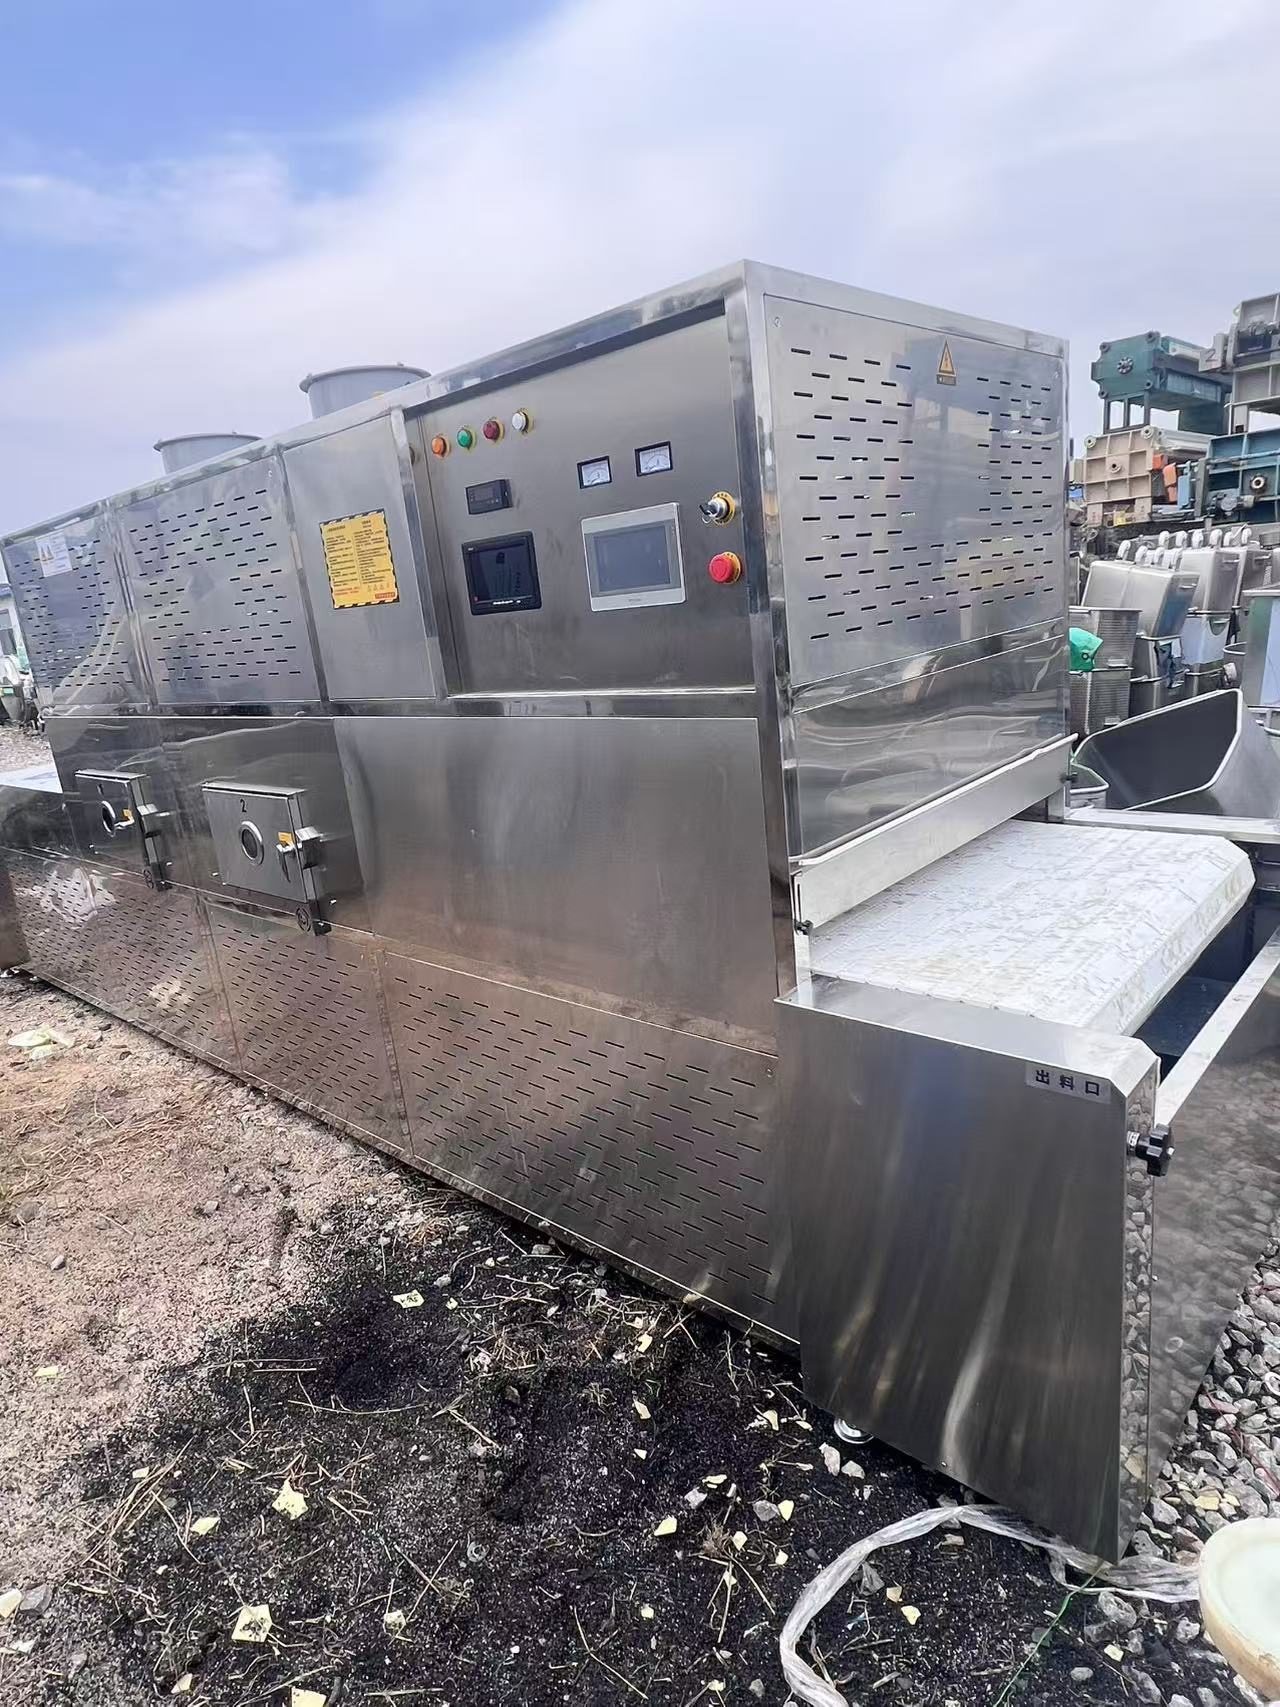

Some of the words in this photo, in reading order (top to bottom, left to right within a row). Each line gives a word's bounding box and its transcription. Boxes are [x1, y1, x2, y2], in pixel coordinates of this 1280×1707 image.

[240, 798, 247, 812] 2
[1035, 1069, 1100, 1096] 出料口
